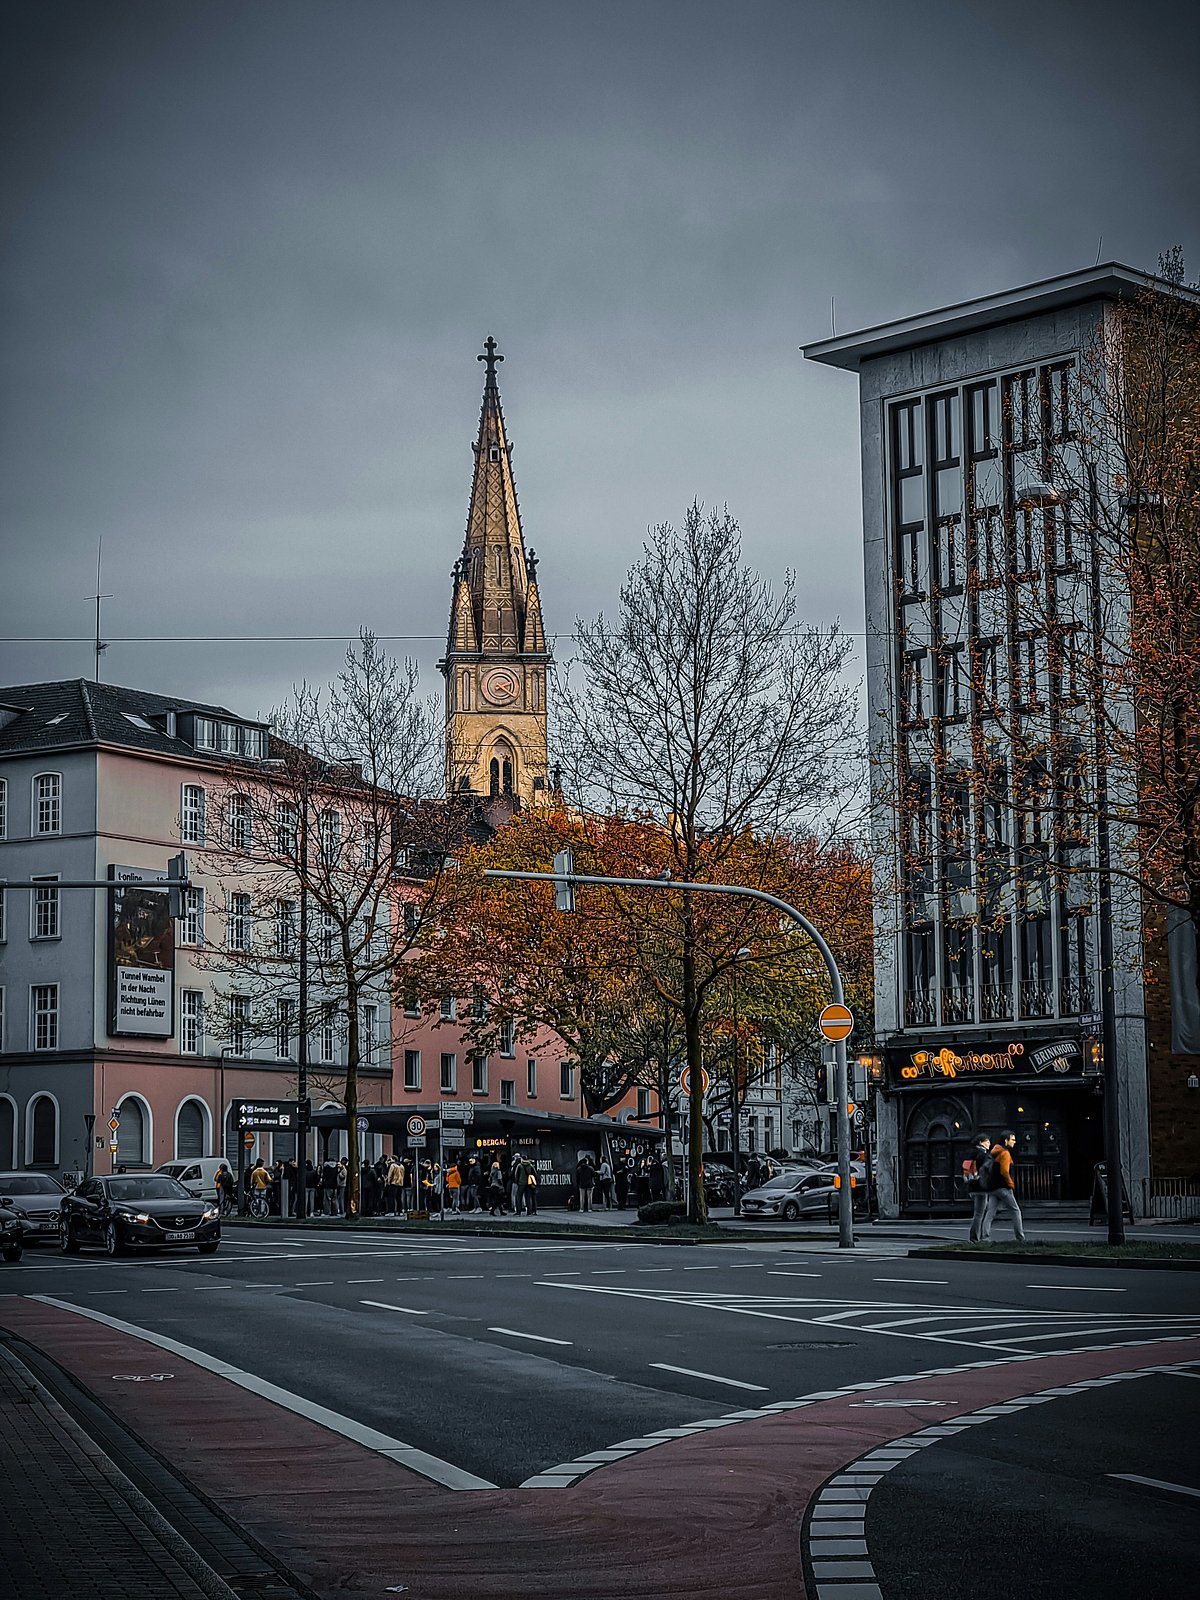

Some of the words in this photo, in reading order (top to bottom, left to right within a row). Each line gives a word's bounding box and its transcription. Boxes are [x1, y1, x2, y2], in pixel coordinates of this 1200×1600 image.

[118, 872, 143, 881] t-online
[121, 971, 141, 981] Tunnel
[142, 973, 166, 983] Wambel
[121, 983, 127, 991] in
[128, 984, 138, 992] der
[139, 985, 156, 993] Nacht
[121, 995, 147, 1006] Richtung
[148, 997, 166, 1006] Lünen
[121, 1007, 136, 1016] nicht
[137, 1007, 165, 1018] befahrbar
[910, 1048, 1015, 1077] Pfefferkorn
[411, 1121, 422, 1131] 30
